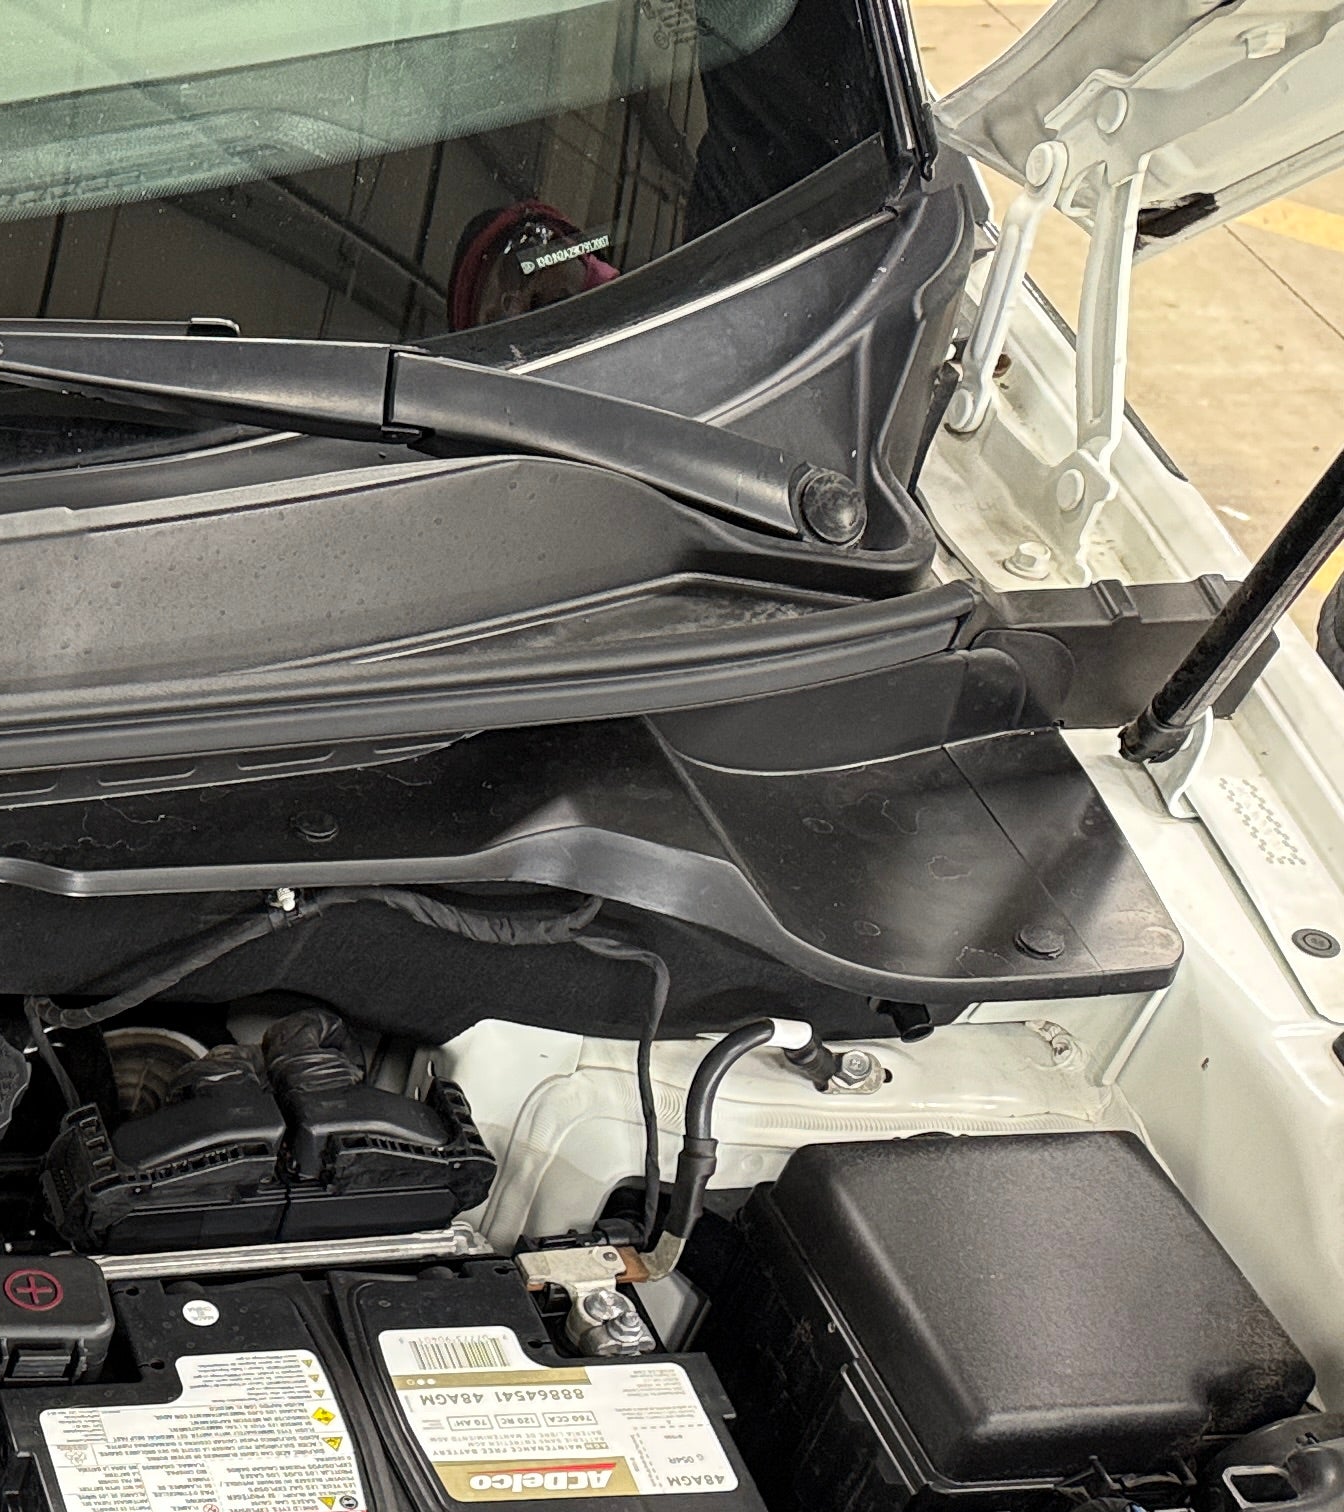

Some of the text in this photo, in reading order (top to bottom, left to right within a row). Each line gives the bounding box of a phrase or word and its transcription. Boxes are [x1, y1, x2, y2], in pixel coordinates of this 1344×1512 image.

[419, 1393, 483, 1406] 48AGM
[494, 1388, 584, 1402] 88864541
[473, 1418, 487, 1426] 70
[500, 1416, 536, 1426] 120 RC
[548, 1414, 569, 1424] CCA
[431, 1447, 477, 1456] BATTERY
[480, 1446, 507, 1454] FREE
[511, 1444, 582, 1453] MAINTENANCE
[469, 1469, 613, 1491] ACDelco
[666, 1474, 725, 1487] 48AGM
